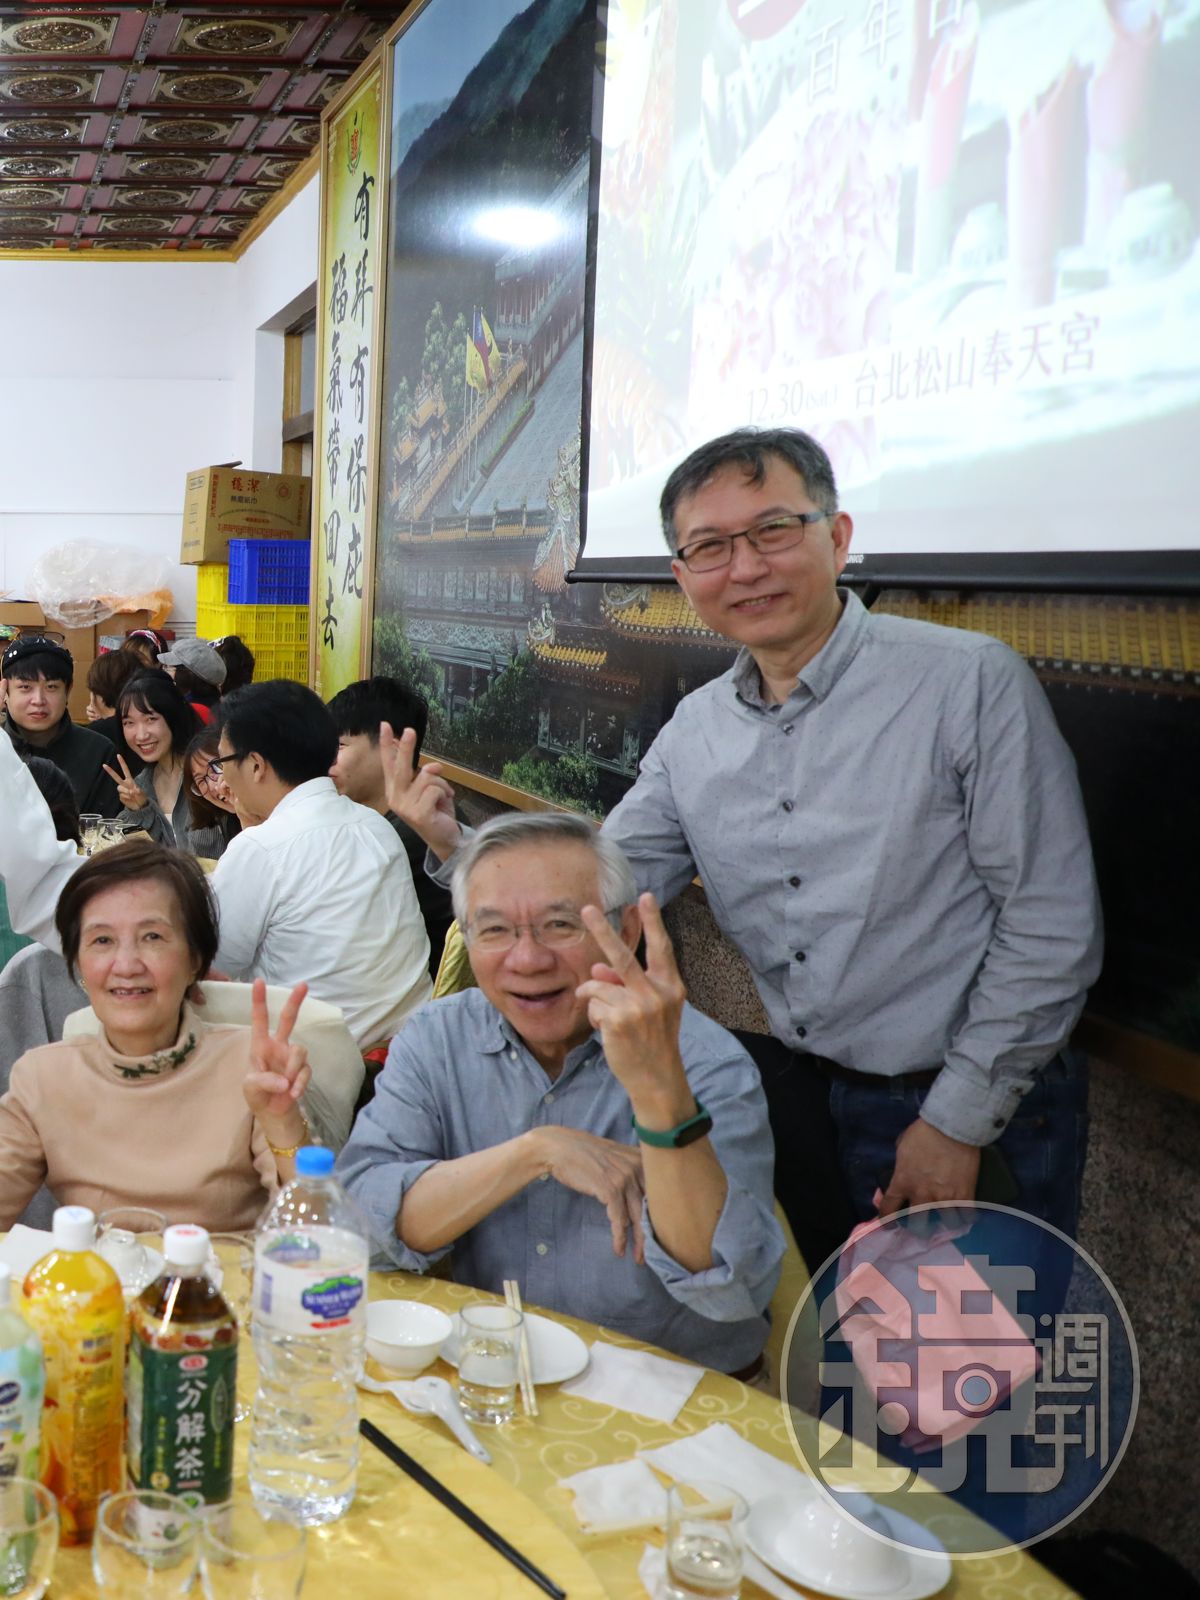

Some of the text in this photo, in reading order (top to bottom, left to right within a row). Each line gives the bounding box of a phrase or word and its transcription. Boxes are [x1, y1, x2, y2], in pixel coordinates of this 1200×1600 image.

[854, 310, 1102, 409] 台北松山奉天宮
[174, 1379, 208, 1478] 分解茶
